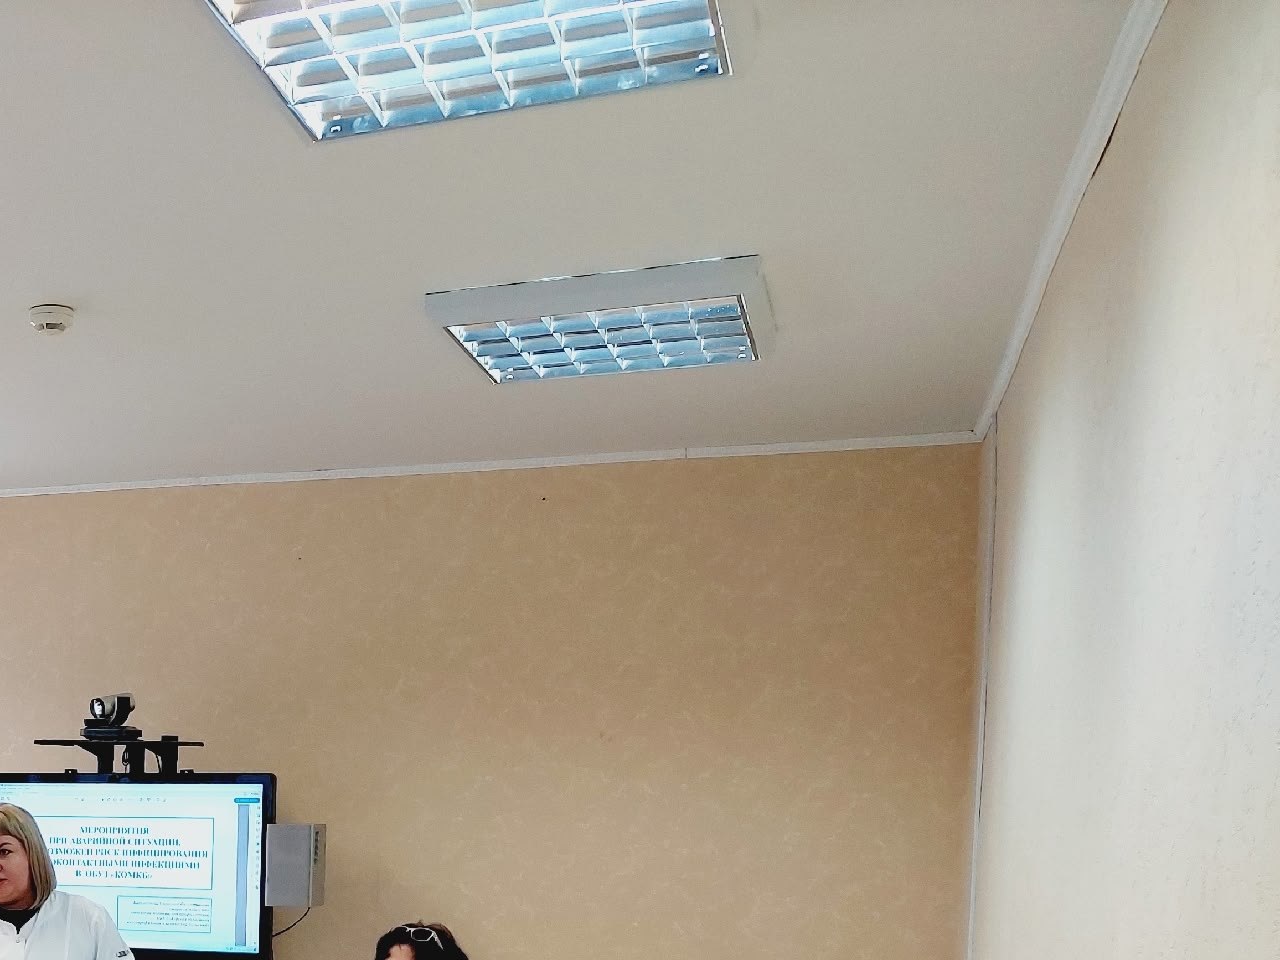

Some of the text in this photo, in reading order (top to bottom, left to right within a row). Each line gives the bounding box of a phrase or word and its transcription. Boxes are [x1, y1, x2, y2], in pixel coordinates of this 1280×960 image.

[80, 826, 149, 835] МЕРОПРИЯТИЯ
[49, 836, 67, 845] ПРИ
[72, 836, 126, 845] АВАРИЙНОЙ
[48, 848, 208, 858] ОЗМОЖЕН РИСК ИНФИЦИРОВАНИЯ
